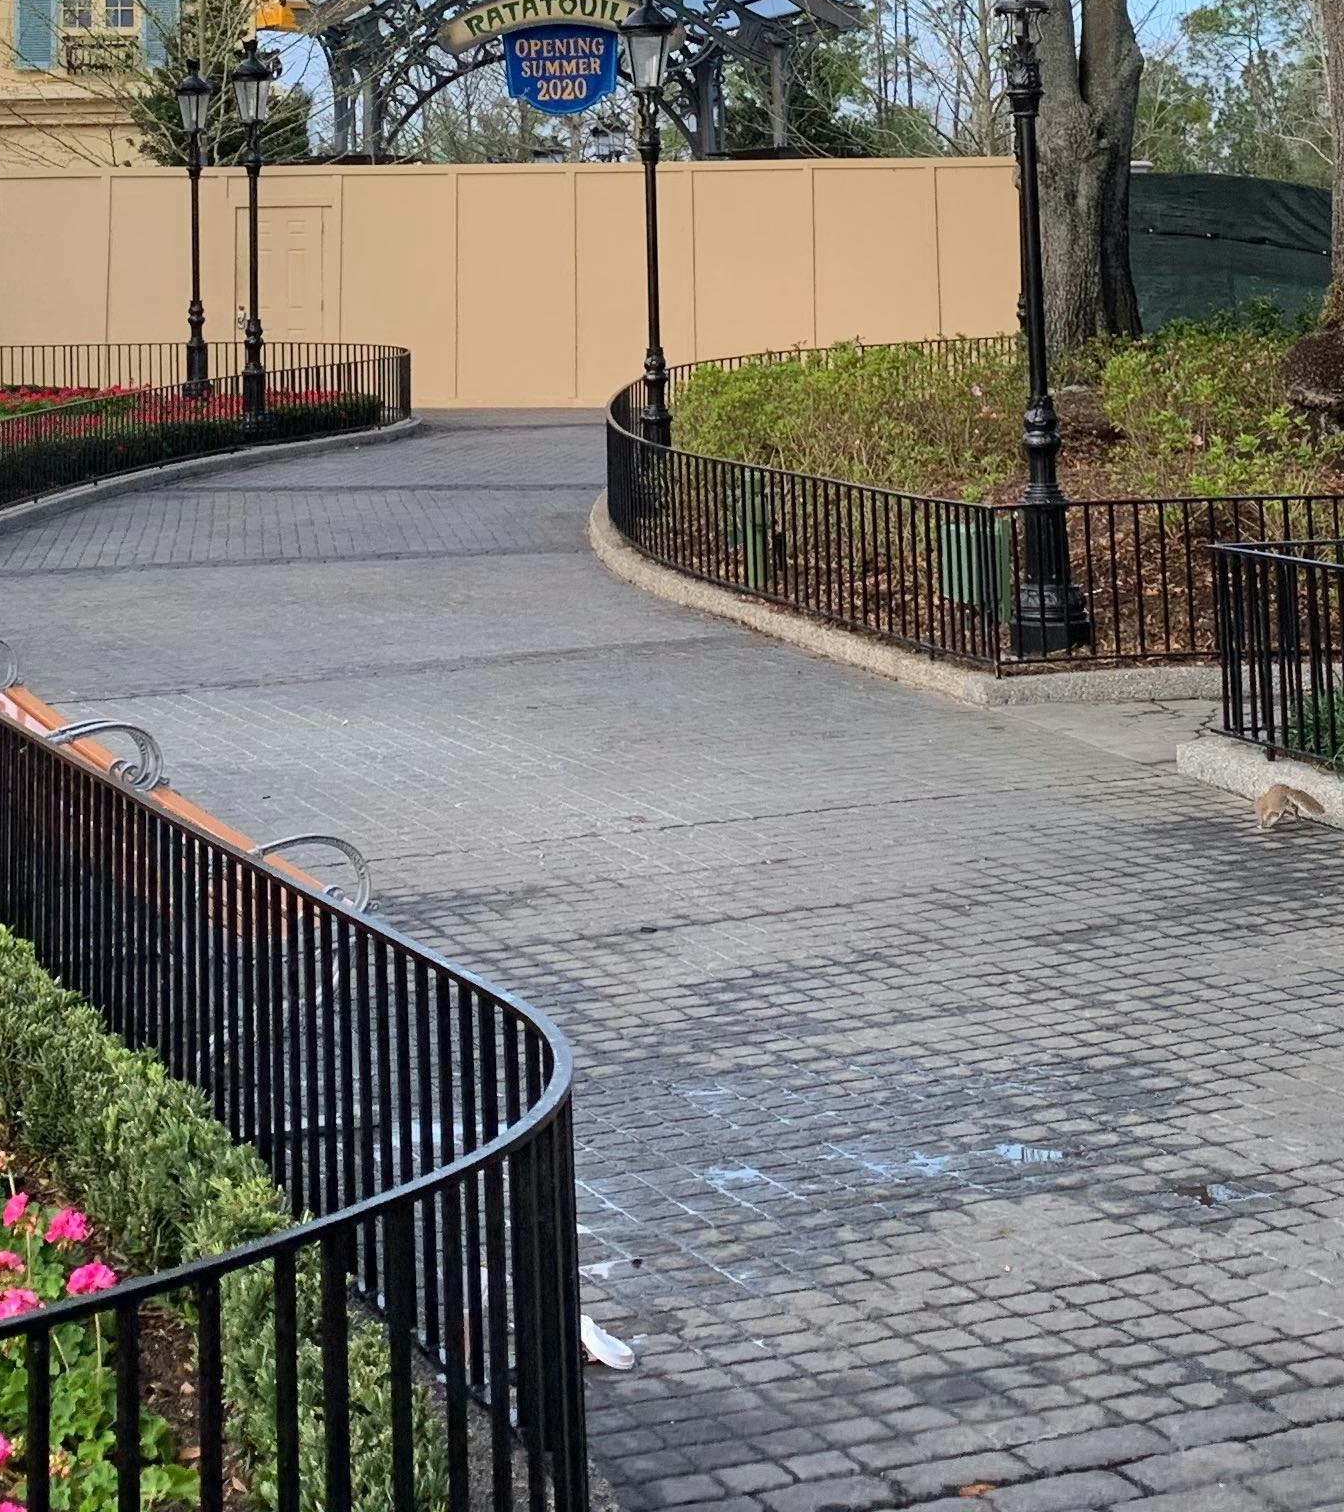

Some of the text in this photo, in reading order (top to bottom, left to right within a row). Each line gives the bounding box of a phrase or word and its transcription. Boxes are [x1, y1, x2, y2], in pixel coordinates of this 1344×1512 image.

[515, 38, 604, 57] OPENING
[521, 58, 602, 77] SUMMER
[537, 78, 587, 100] 2020
